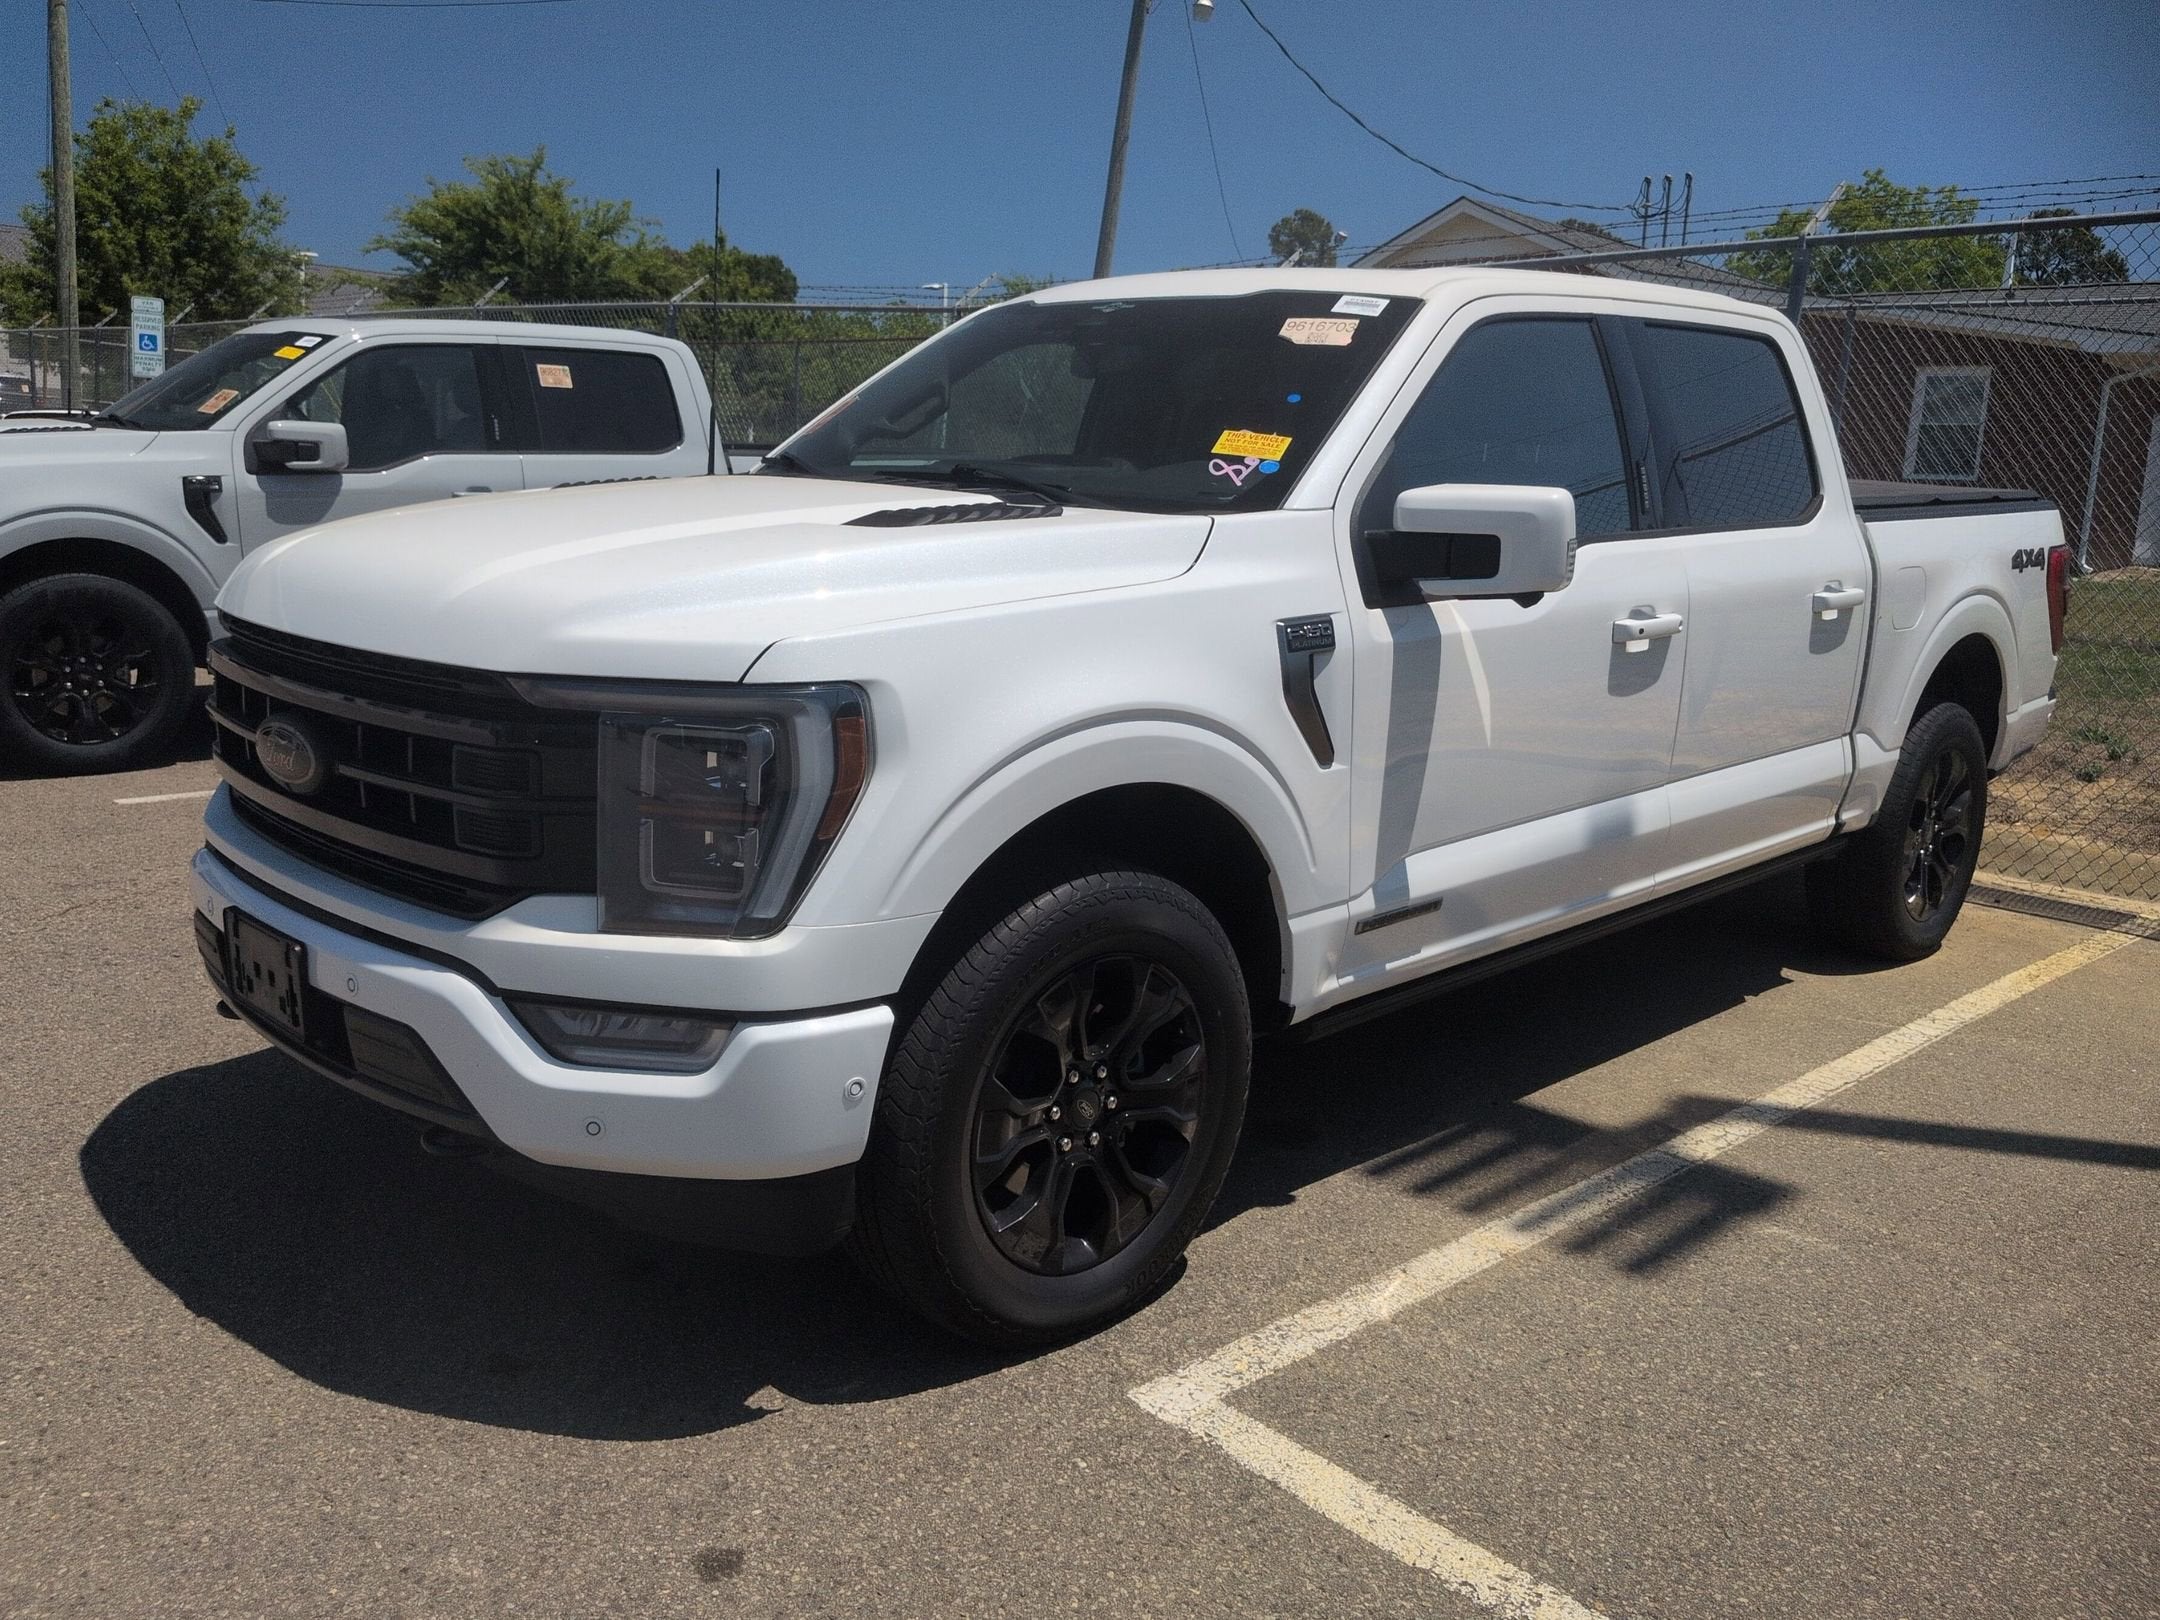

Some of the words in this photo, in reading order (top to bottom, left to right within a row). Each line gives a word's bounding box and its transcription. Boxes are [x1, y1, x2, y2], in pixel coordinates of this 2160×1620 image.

[136, 323, 161, 332] PARKING
[1285, 321, 1357, 333] 9616703
[1226, 432, 1247, 440] THIS
[1249, 433, 1286, 444] VEHICLE
[1242, 439, 1259, 447] FOR
[1260, 441, 1281, 449] SALE
[1287, 623, 1332, 640] F-150
[1291, 637, 1333, 649] PLATINUM
